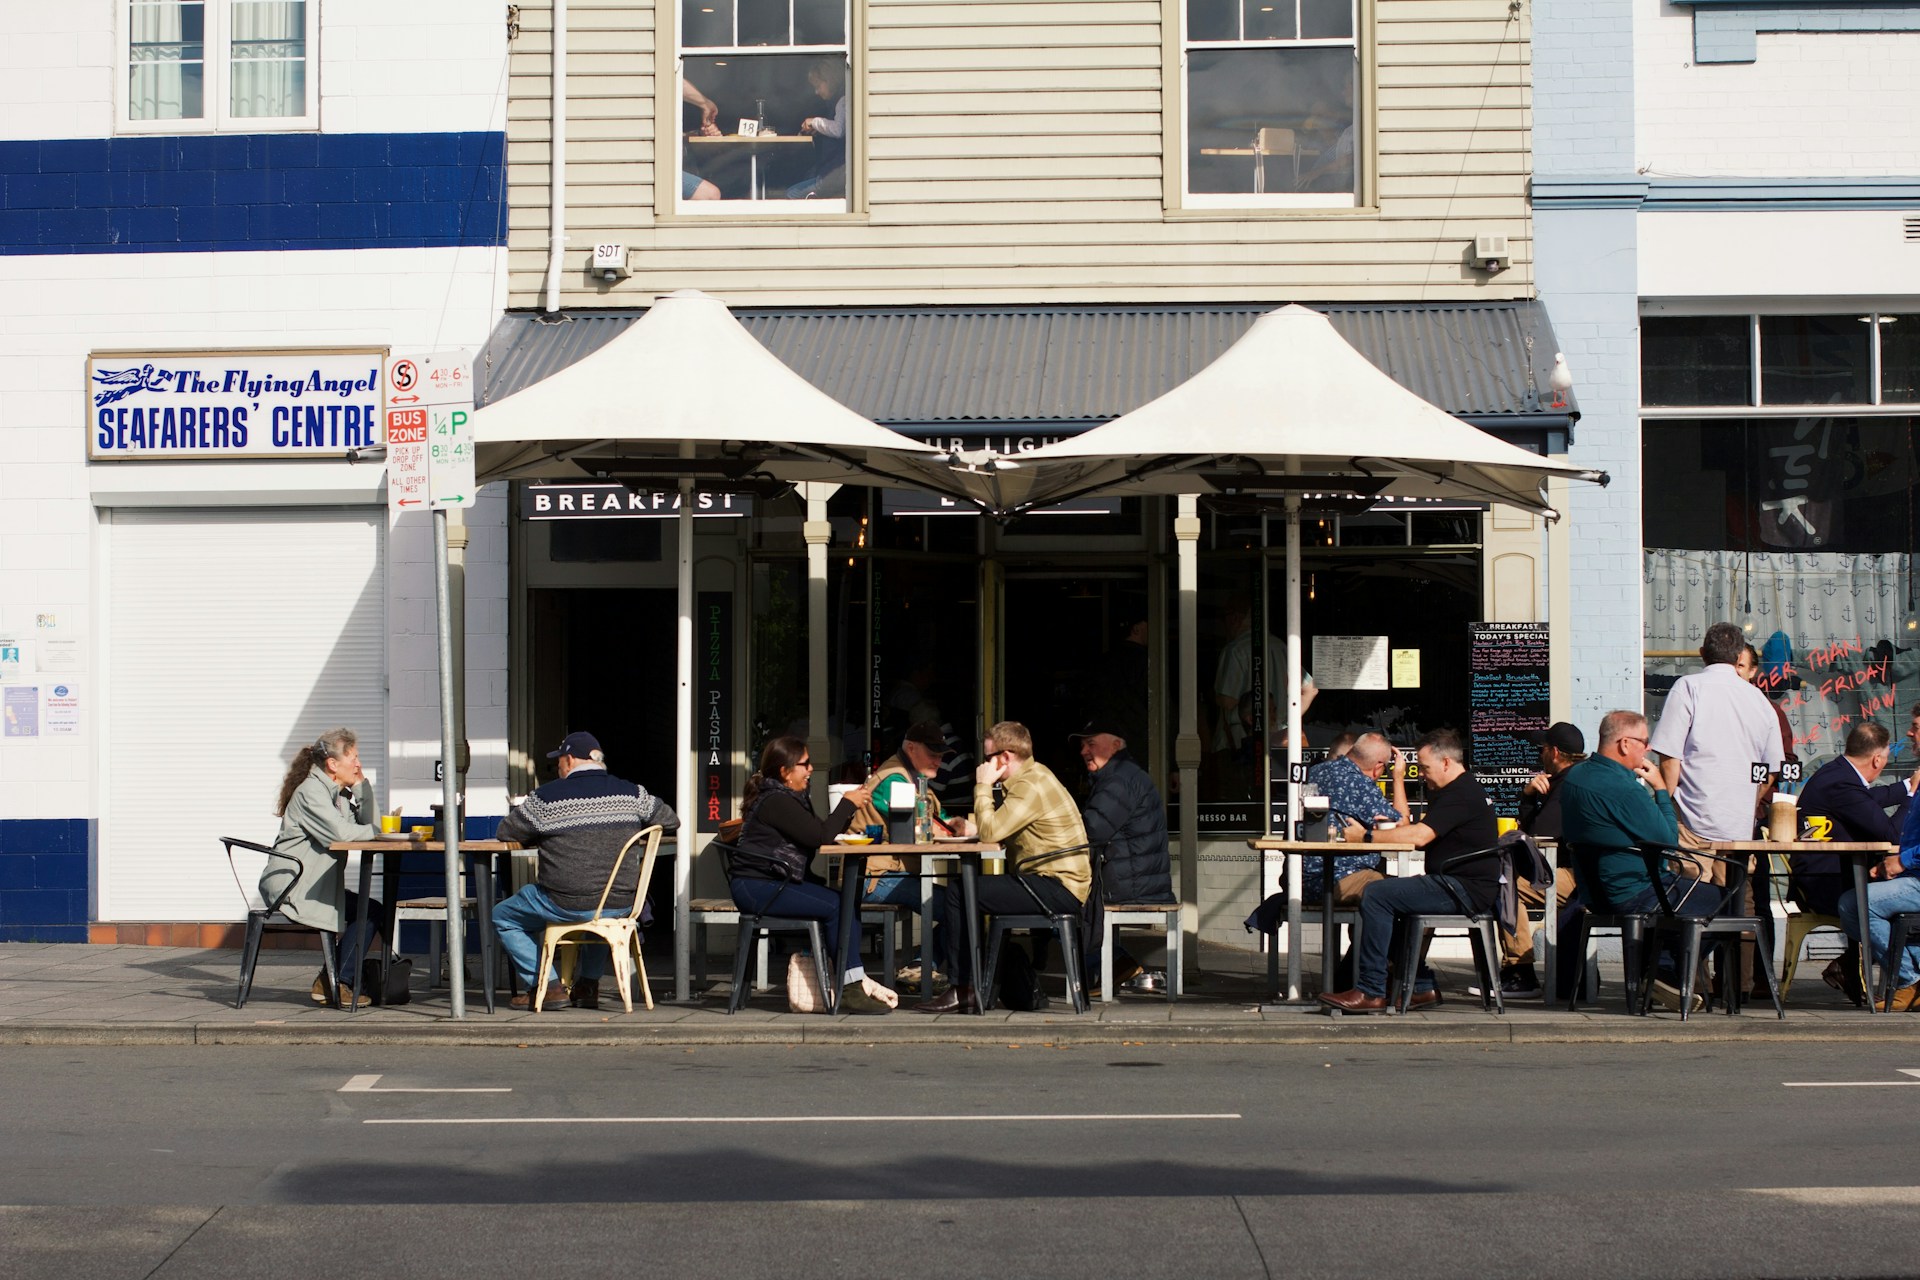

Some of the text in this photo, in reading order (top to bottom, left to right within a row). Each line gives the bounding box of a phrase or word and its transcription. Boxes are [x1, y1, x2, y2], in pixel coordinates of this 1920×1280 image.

[743, 122, 755, 134] 18
[598, 244, 621, 258] SDT
[223, 370, 305, 398] Flying
[304, 369, 378, 398] Angel
[99, 402, 375, 449] SEAFARERS' CENTRE
[393, 411, 422, 426] BUS
[389, 427, 426, 442] ZONE
[392, 454, 423, 464] DROP OFF
[395, 446, 421, 455] PICK UP
[400, 463, 416, 472] ZONE
[392, 476, 426, 486] ALL OTHER
[400, 485, 418, 493] TIMES
[709, 606, 721, 680] PIZZA
[1805, 633, 1863, 671] THAN
[1819, 655, 1888, 700] FRIDAY
[873, 654, 882, 728] PASTA
[1254, 656, 1263, 732] PASTA
[1830, 715, 1851, 732] ON
[1860, 683, 1896, 720] NOW
[709, 690, 721, 765] PASTA
[1293, 764, 1307, 782] 91
[1752, 765, 1768, 782] 92
[1782, 763, 1800, 780] 93
[708, 775, 721, 820] BAR
